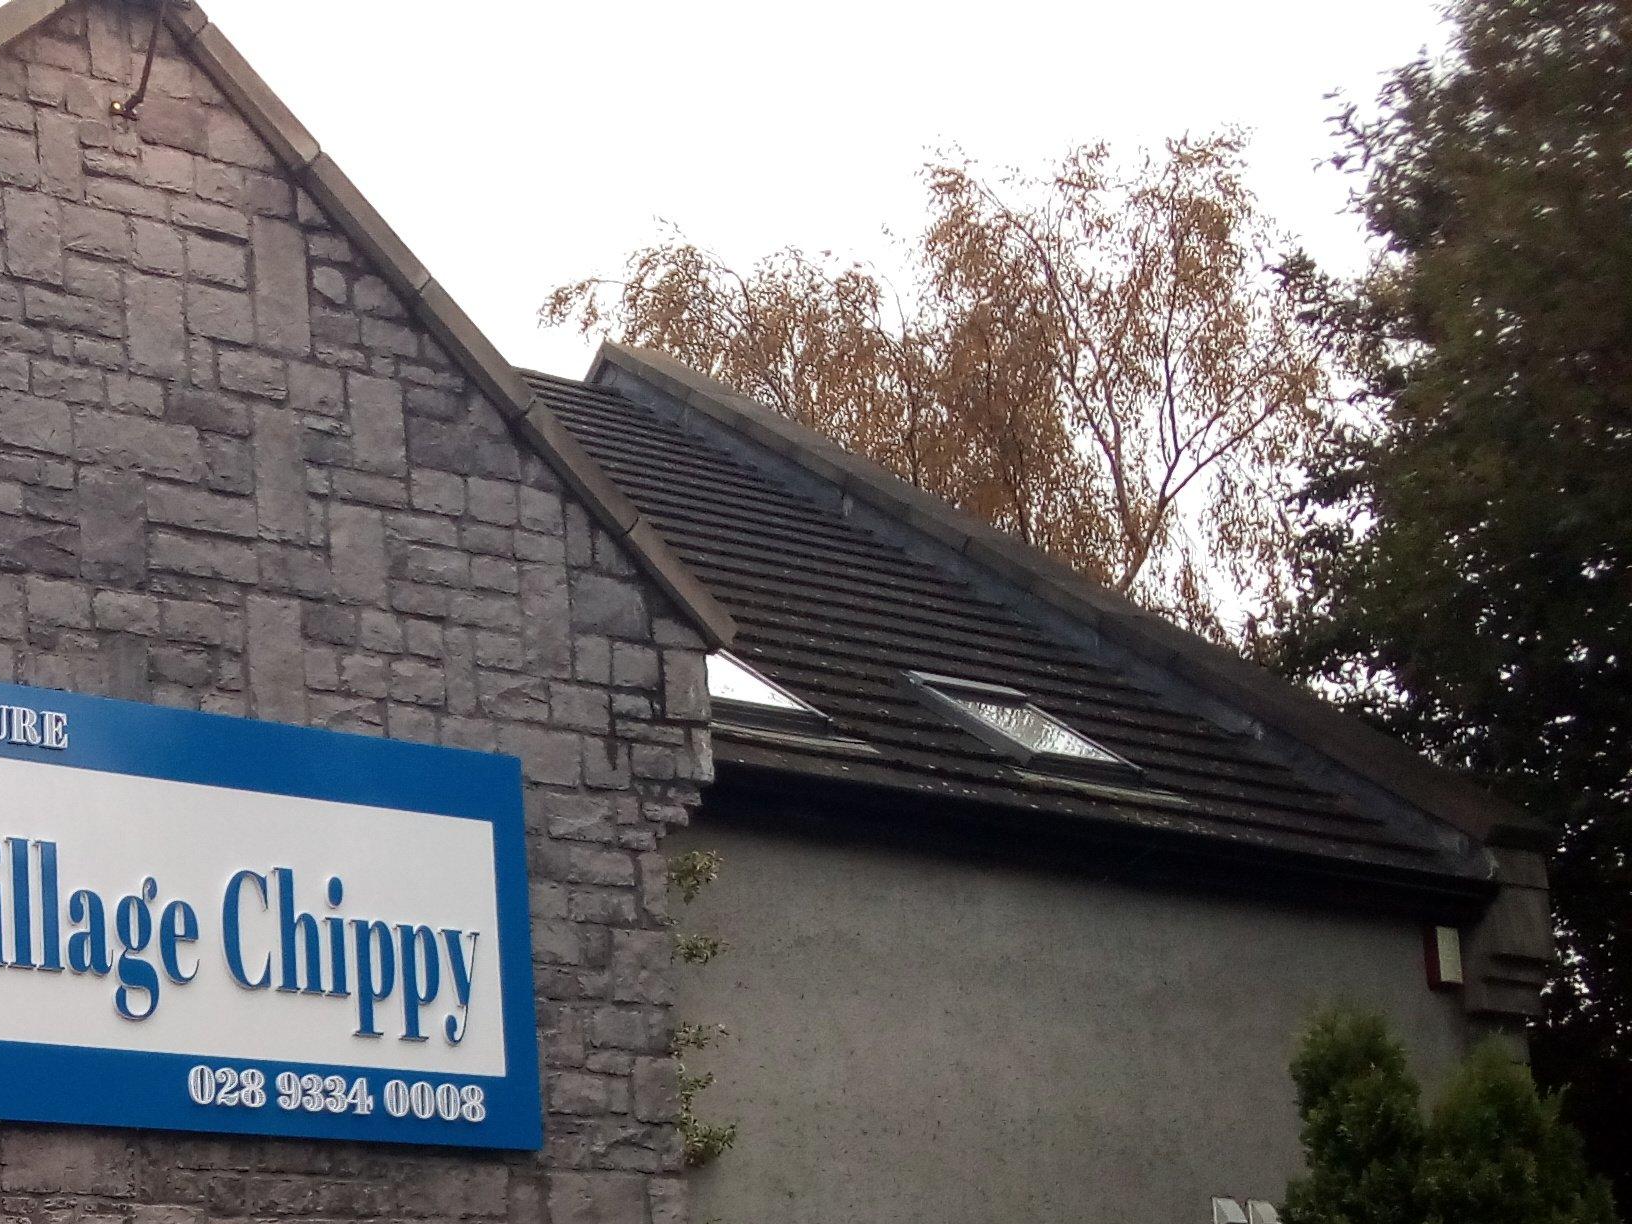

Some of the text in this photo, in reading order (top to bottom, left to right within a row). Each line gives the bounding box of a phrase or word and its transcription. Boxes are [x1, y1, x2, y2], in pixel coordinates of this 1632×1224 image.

[222, 866, 480, 1046] Chippy
[188, 1063, 487, 1123] 028 9334 0008
